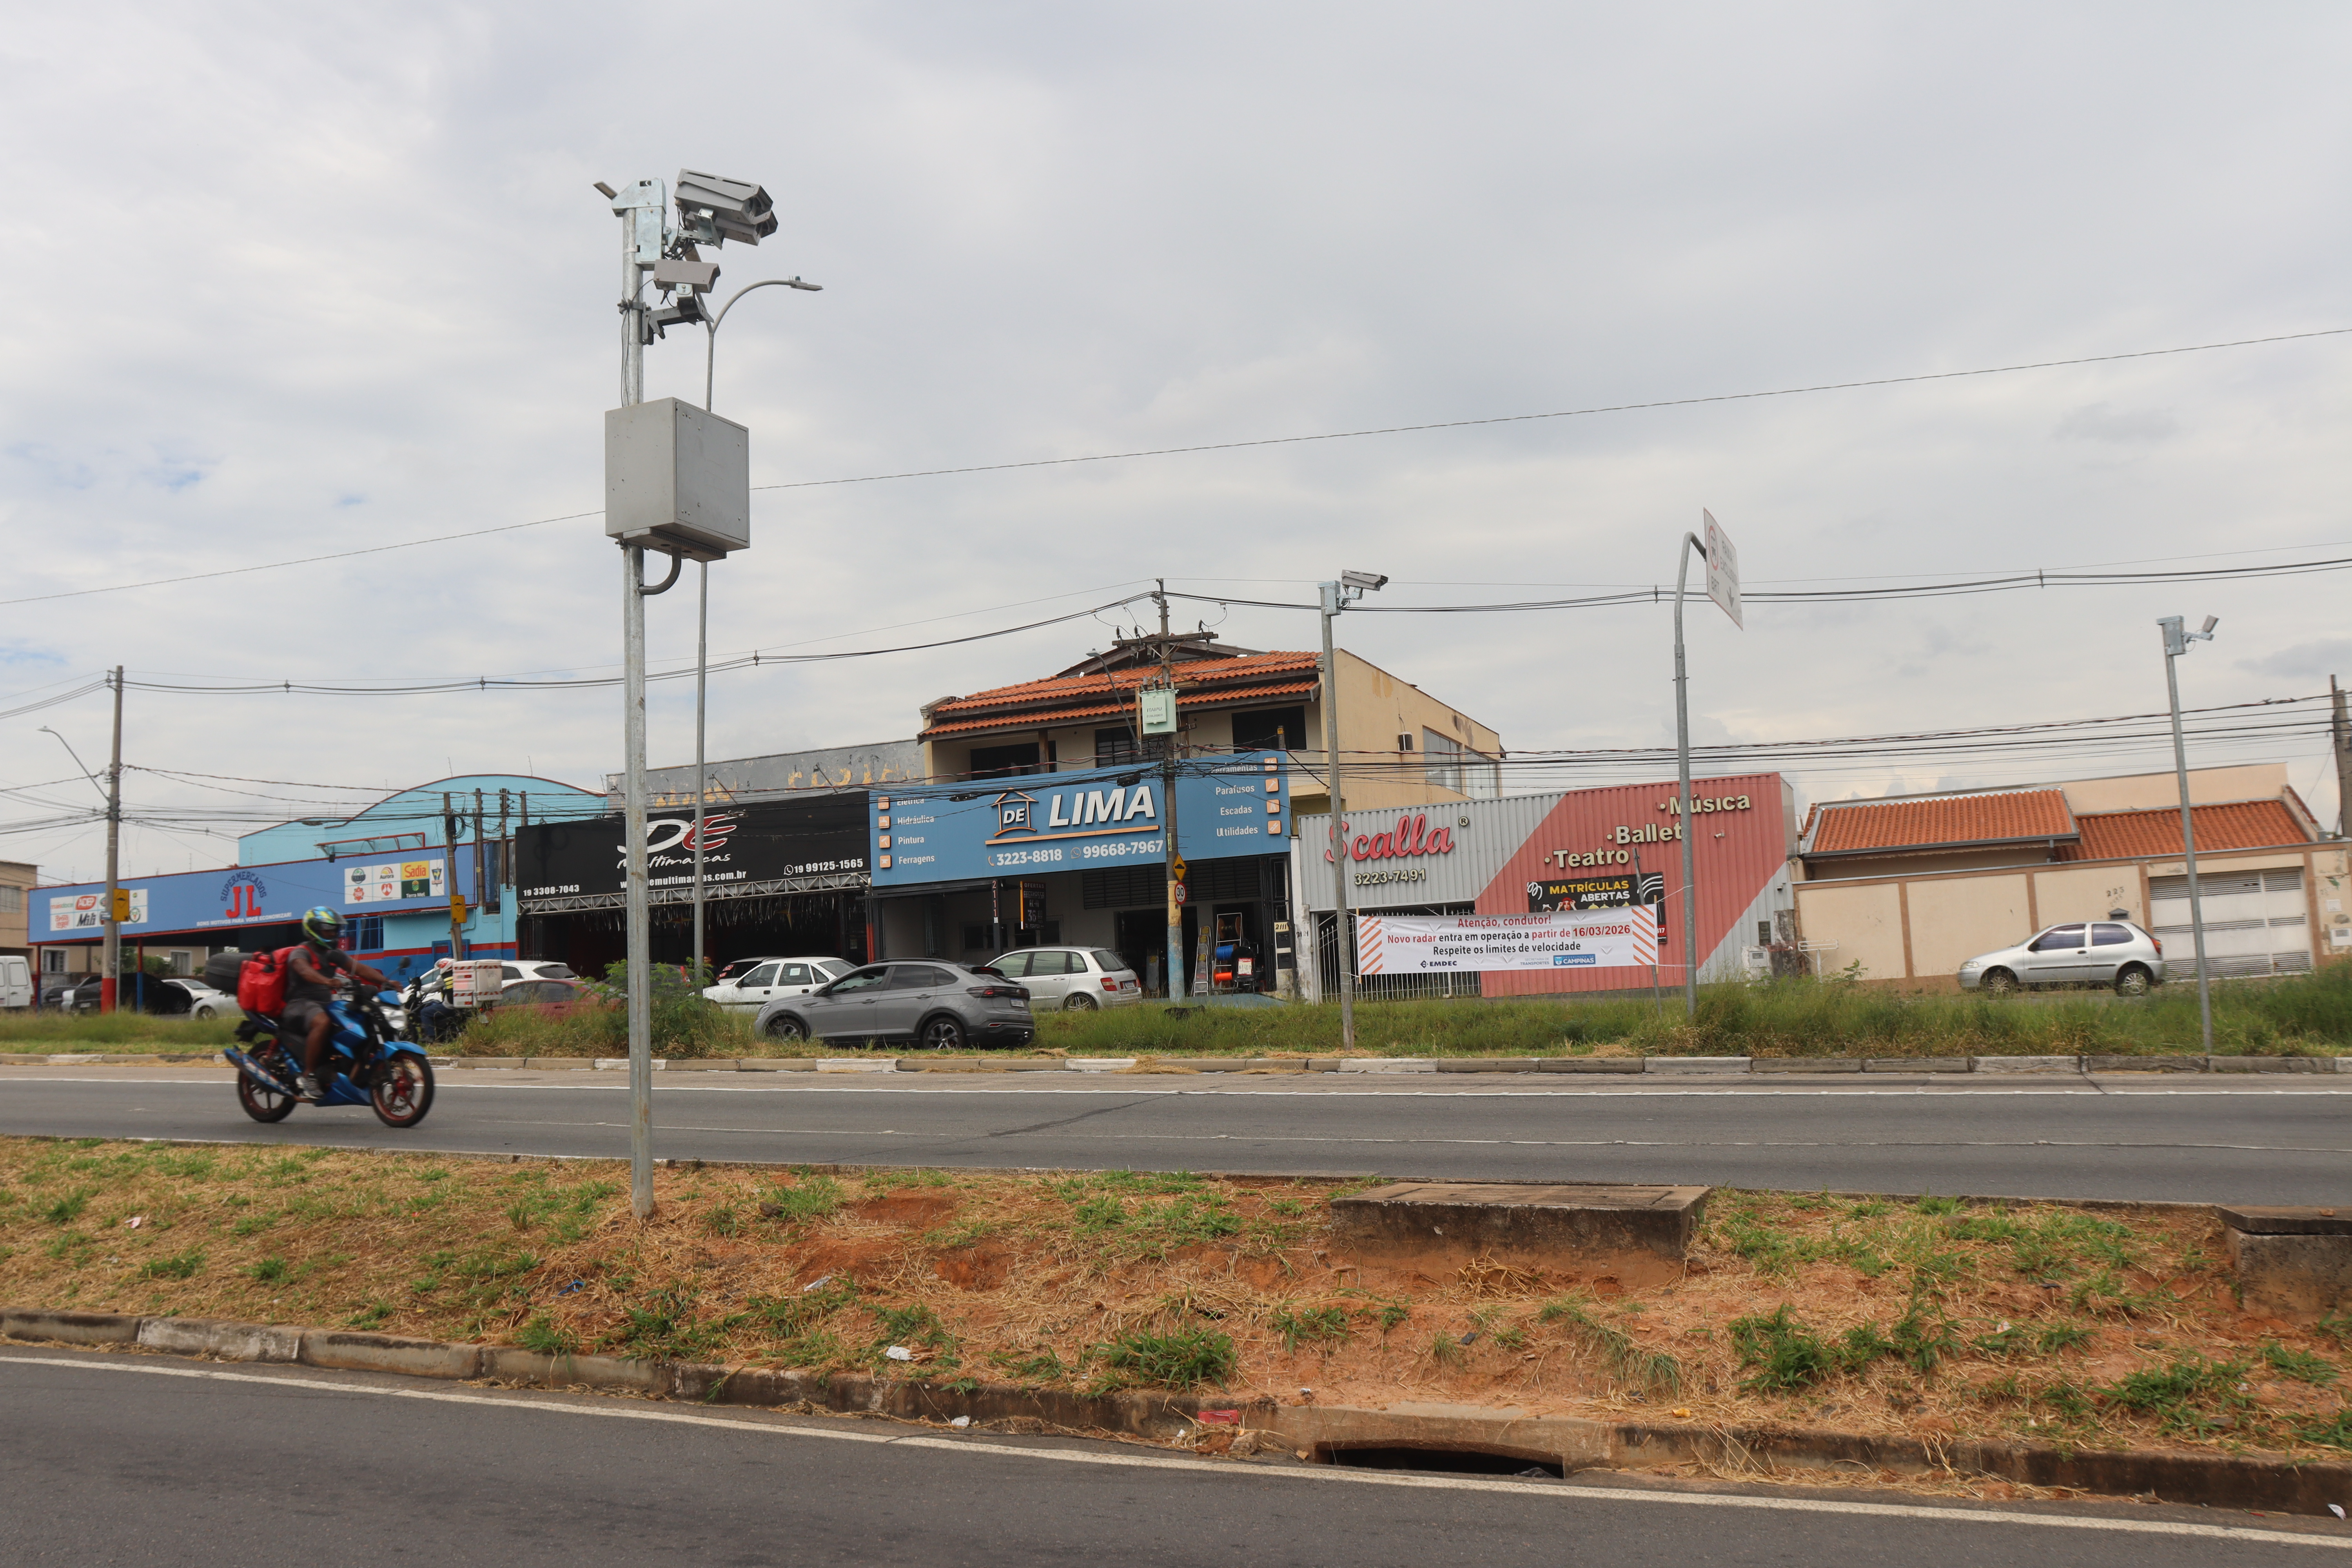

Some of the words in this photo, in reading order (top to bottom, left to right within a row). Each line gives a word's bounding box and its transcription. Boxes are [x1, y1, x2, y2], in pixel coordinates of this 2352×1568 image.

[1216, 785, 1255, 795] Parafusos
[1049, 785, 1155, 827] LIMA
[1220, 805, 1252, 816] Escadas
[1669, 794, 1750, 815] Música
[897, 815, 935, 825] Hidráulica
[1003, 808, 1025, 824] DE
[1216, 826, 1258, 837] Utilidades
[1325, 813, 1454, 862] Scalla
[1616, 821, 1682, 844] Ballet
[898, 837, 924, 845] Pintura
[1083, 840, 1163, 858] 99668-7967
[898, 855, 935, 865] Ferragens
[996, 849, 1062, 866] 3223-8818
[1553, 847, 1630, 868] Teatro
[405, 865, 426, 878] Sadia
[794, 865, 804, 873] 19
[806, 858, 863, 873] 99125-1565
[1354, 868, 1426, 885] 3223-7491
[220, 871, 267, 902] SUPERMERCADOS
[533, 884, 580, 896] 3308-7043
[1177, 887, 1184, 897] 30
[1549, 880, 1629, 895] MATRÍCULAS
[225, 885, 261, 918] JL
[1580, 891, 1630, 902] ABERTAS
[76, 913, 96, 927] Mili
[259, 912, 292, 921] ECONOMIZAR!
[1458, 918, 1501, 929] Atenção,
[1503, 915, 1551, 926] condutor!
[1388, 935, 1410, 943] Novo
[1413, 934, 1436, 943] radar
[1481, 930, 1522, 942] operação
[1532, 929, 1557, 940] partir
[1560, 928, 1571, 937] de
[1573, 924, 1630, 937] 16/03/2026
[1434, 945, 1471, 956] Respeite
[1486, 944, 1516, 953] limites
[1519, 943, 1529, 952] de
[1532, 942, 1581, 952] velocidade
